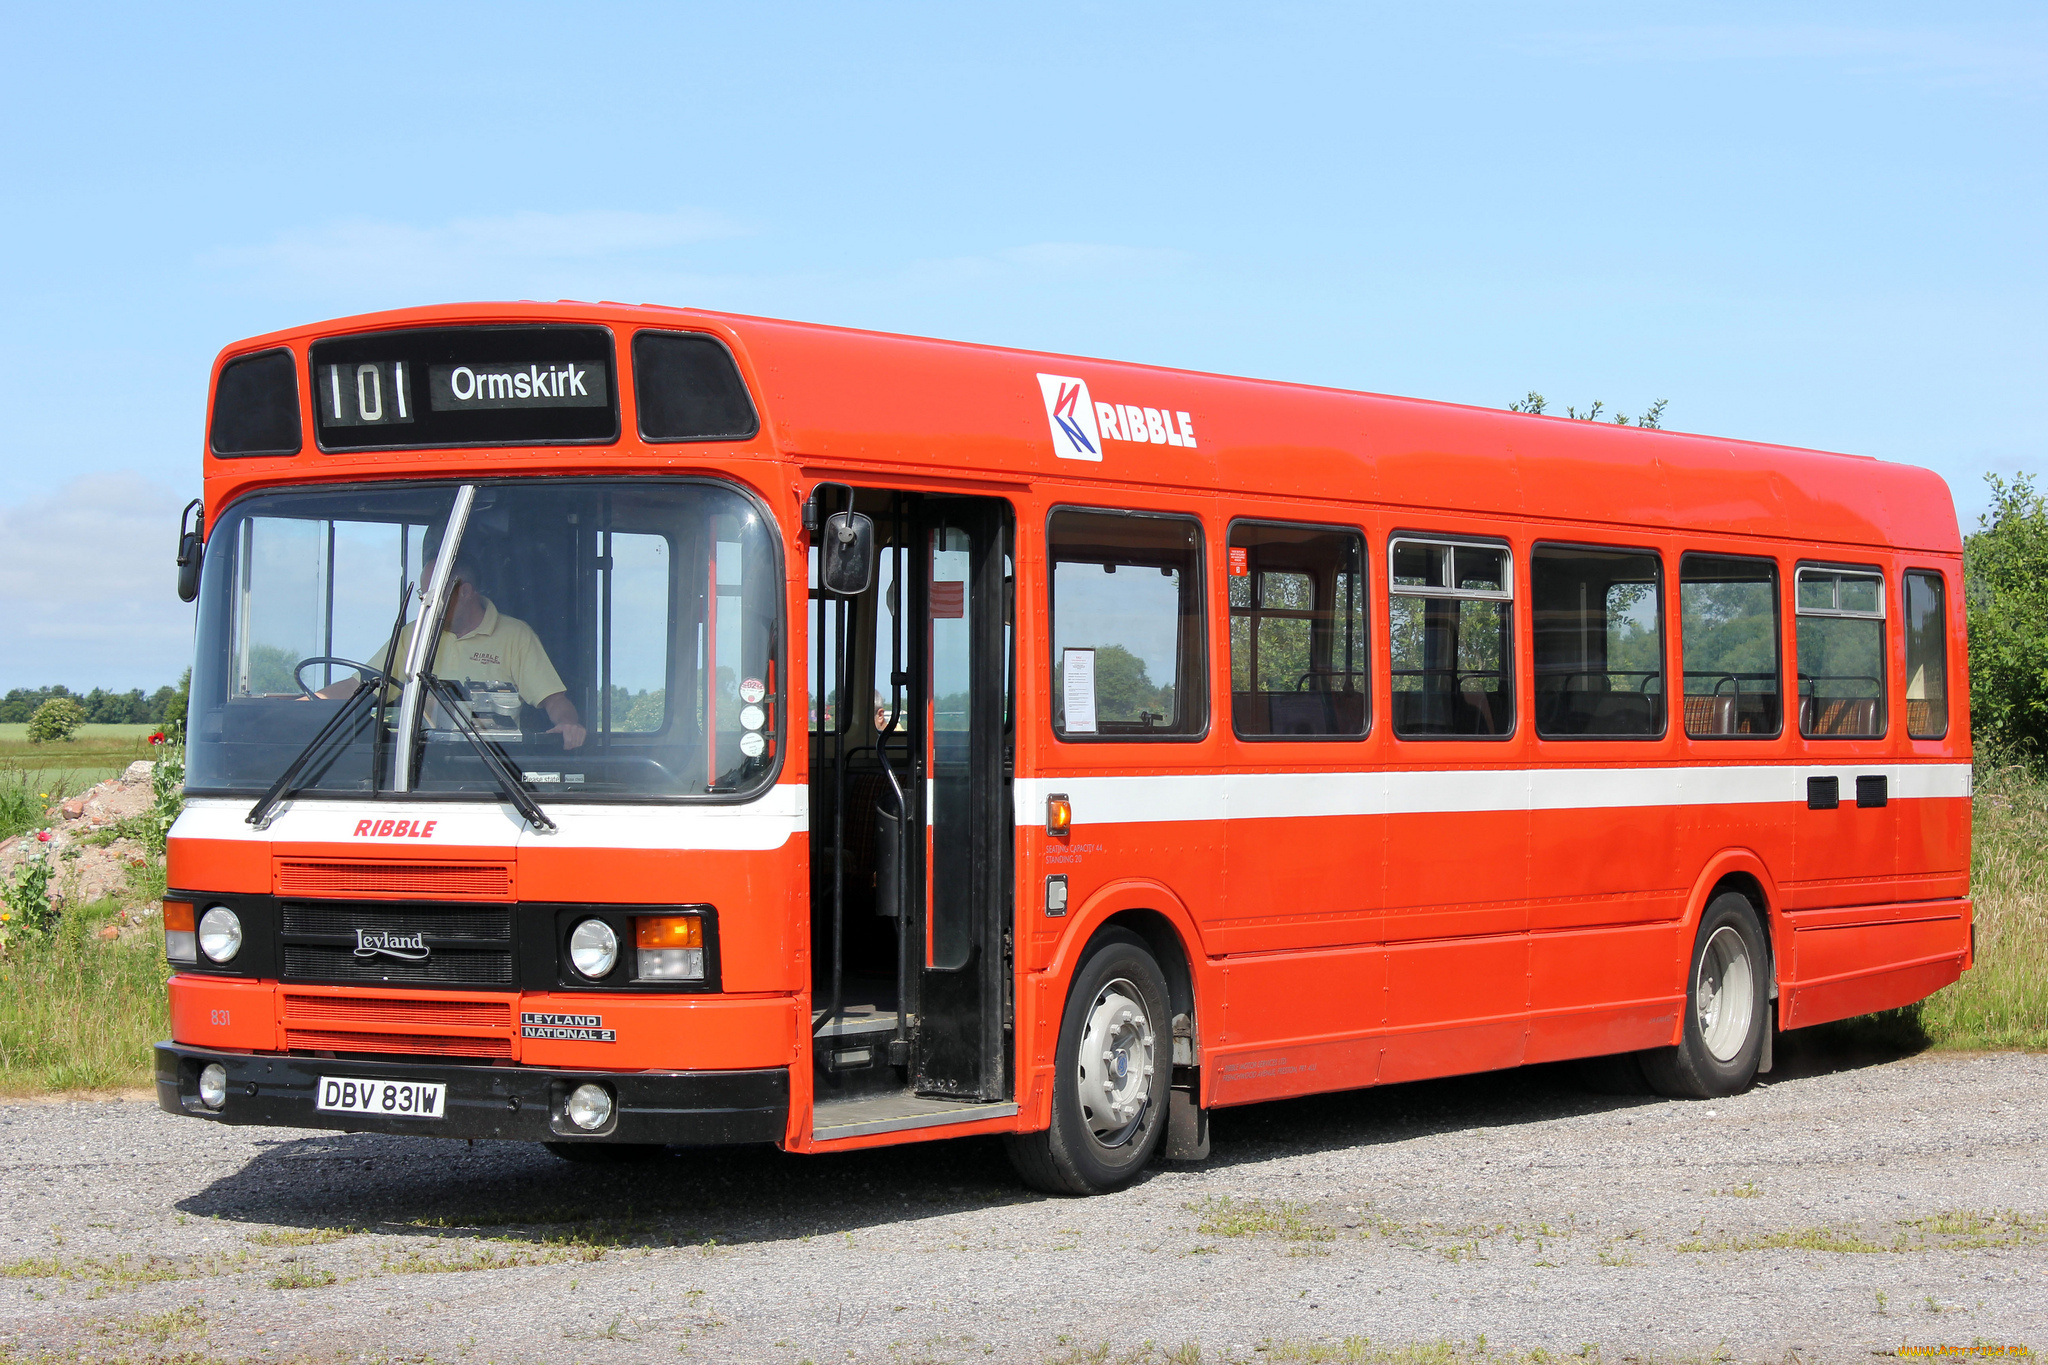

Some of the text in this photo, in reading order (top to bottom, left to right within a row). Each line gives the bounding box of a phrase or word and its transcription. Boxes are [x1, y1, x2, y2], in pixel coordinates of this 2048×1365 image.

[331, 362, 588, 421] 101 Ormskirk
[1094, 401, 1198, 449] RIBBLE
[353, 819, 438, 838] RIBBLE
[1046, 844, 1103, 853] SEATING CAPACITY 44
[1046, 855, 1074, 864] STANDING
[354, 929, 431, 959] Leyland
[211, 1009, 231, 1026] 831
[525, 1014, 597, 1026] LEYLAND
[525, 1027, 612, 1040] NATIONAL 2
[325, 1081, 438, 1113] DBV 831W
